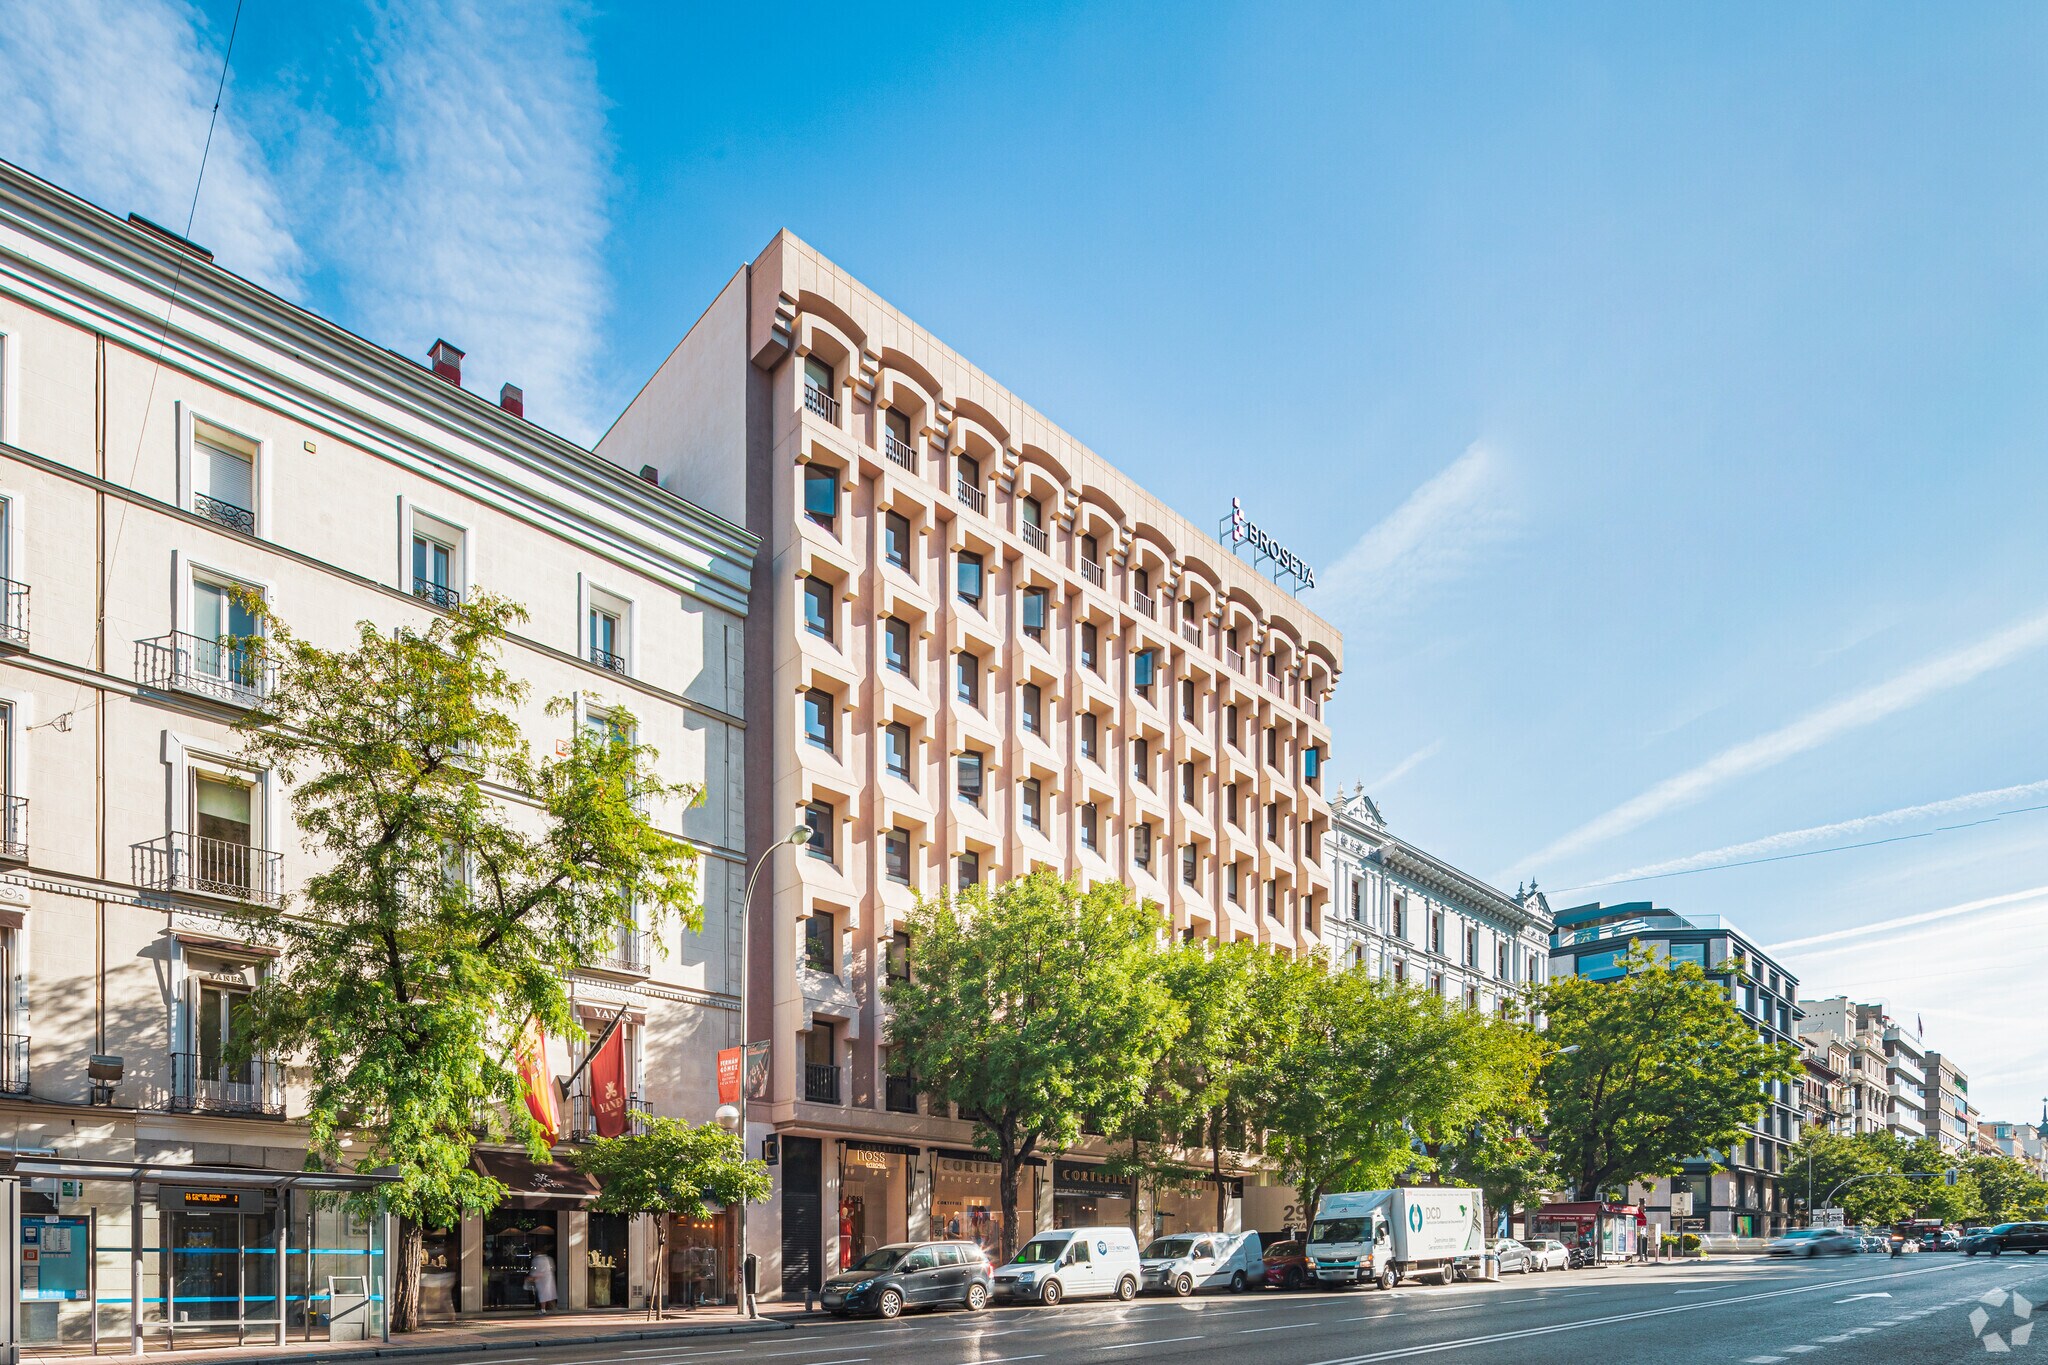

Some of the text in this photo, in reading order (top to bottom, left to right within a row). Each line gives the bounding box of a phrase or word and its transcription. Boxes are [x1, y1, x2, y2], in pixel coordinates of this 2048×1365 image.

[1247, 521, 1316, 589] BROSETA
[209, 972, 243, 984] YANES
[858, 1150, 886, 1163] hoss
[943, 1160, 1001, 1175] CORTEF
[1283, 1205, 1306, 1221] 29
[1426, 1207, 1441, 1220] DCD
